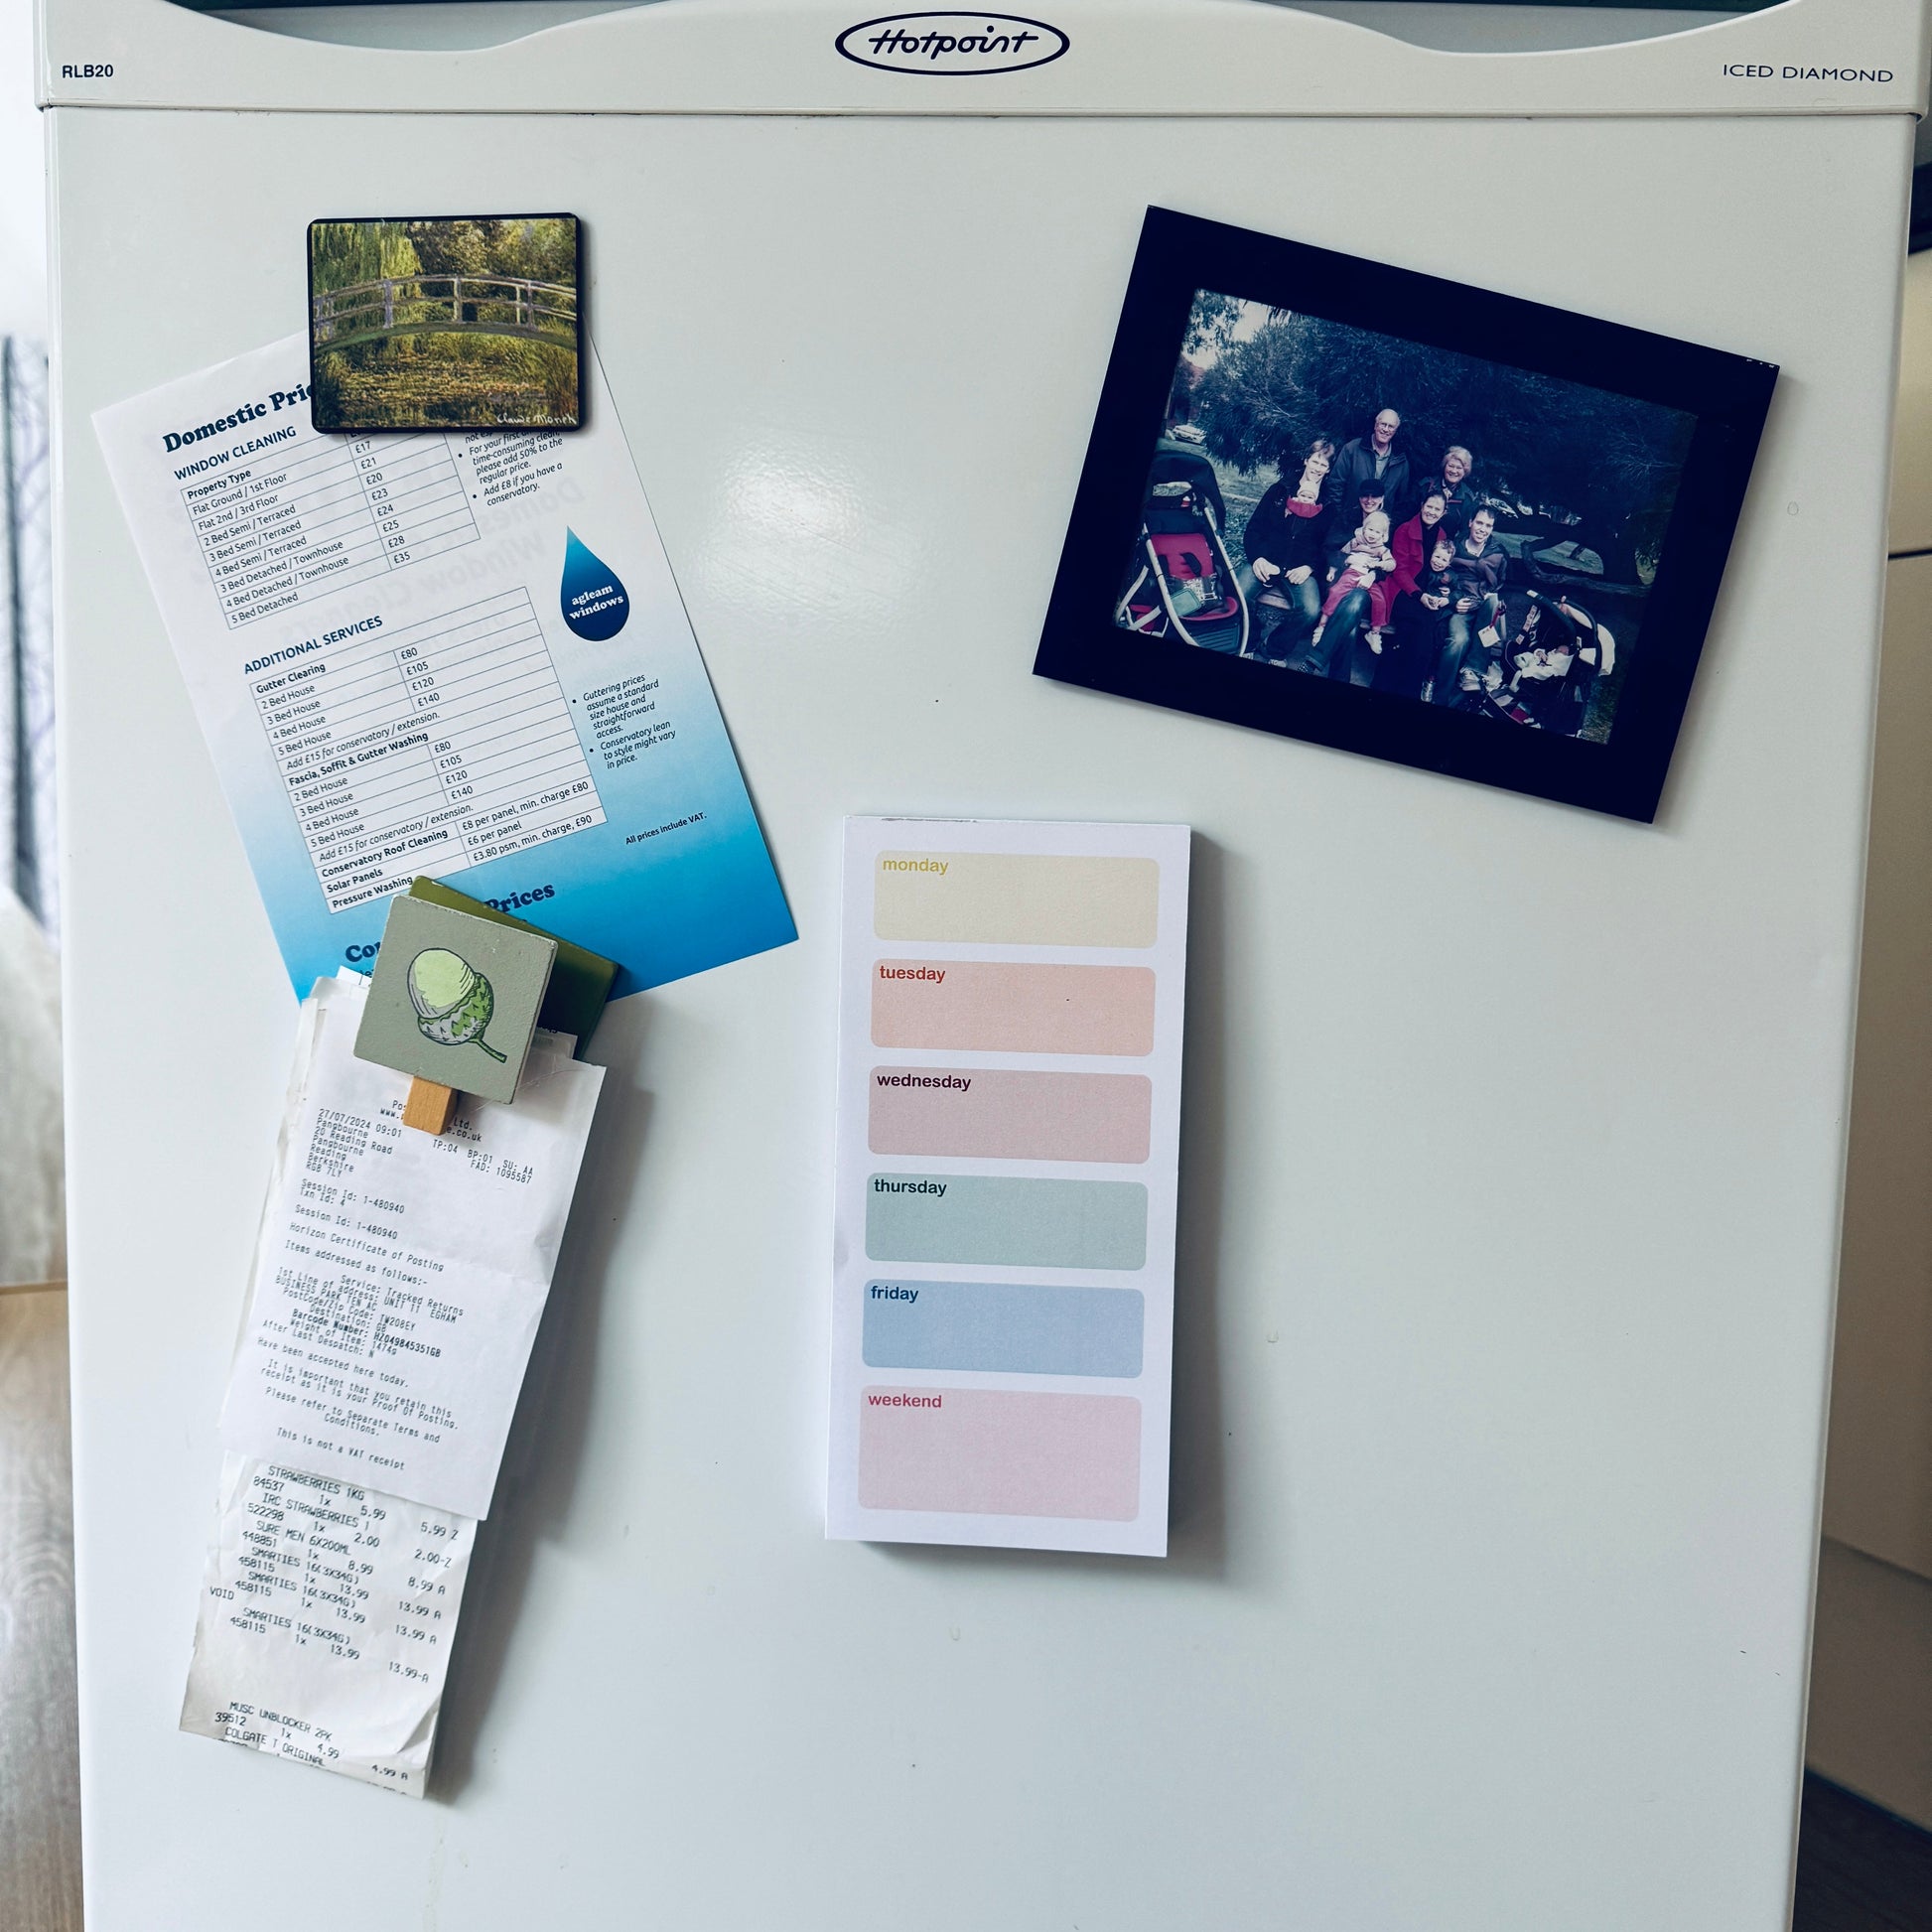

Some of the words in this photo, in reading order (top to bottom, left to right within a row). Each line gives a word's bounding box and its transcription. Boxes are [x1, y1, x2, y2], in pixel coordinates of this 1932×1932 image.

[869, 26, 1038, 60] Hotpoint
[63, 65, 113, 78] RLB20
[1724, 65, 1773, 77] ICED
[1783, 67, 1892, 81] DIAMOND
[162, 403, 267, 453] Domestic
[174, 450, 229, 480] WINDOW
[231, 425, 296, 458] CLEANING
[354, 440, 370, 453] £17
[476, 460, 501, 477] please
[502, 452, 519, 465] add
[519, 444, 537, 460] 50%
[538, 443, 548, 452] to
[548, 438, 562, 448] the
[360, 457, 376, 469] £21
[479, 468, 507, 484] regular
[508, 461, 531, 476] price.
[187, 479, 226, 499] Property
[226, 470, 251, 483] Type
[365, 472, 383, 484] £20
[483, 483, 499, 496] Add
[500, 479, 511, 489] £8
[512, 475, 518, 487] if
[519, 472, 535, 485] you
[535, 465, 555, 478] have
[371, 487, 388, 500] £23
[486, 483, 541, 506] conservatory.
[376, 503, 393, 516] £24
[382, 519, 399, 532] £25
[387, 535, 405, 548] £28
[393, 550, 410, 564] £35
[571, 585, 614, 605] agleam
[231, 614, 238, 623] 5
[237, 607, 256, 621] Bed
[255, 591, 298, 614] Detached
[569, 596, 623, 619] windows
[244, 638, 322, 674] ADDITIONAL
[322, 615, 382, 645] SERVICES
[400, 646, 418, 659] £80
[256, 677, 286, 693] Gutter
[287, 663, 326, 682] Clearing
[406, 660, 429, 675] £105
[411, 676, 434, 691] £120
[583, 682, 621, 701] Guttering
[621, 674, 645, 689] prices
[586, 695, 616, 711] assume
[623, 678, 659, 698] standard
[261, 700, 268, 709] 2
[268, 693, 287, 706] Bed
[286, 685, 315, 700] House
[417, 692, 440, 706] £140
[589, 709, 605, 720] size
[606, 701, 629, 715] house
[630, 693, 646, 706] and
[593, 701, 655, 730] straightforward
[596, 724, 623, 739] access.
[600, 727, 651, 750] Conservatory
[652, 721, 670, 732] lean
[614, 744, 632, 757] style
[633, 735, 658, 750] might
[657, 730, 675, 741] vary
[288, 770, 320, 785] Fascia,
[320, 759, 347, 774] Soffit
[356, 746, 387, 761] Gutter
[387, 733, 429, 751] Washing
[616, 754, 637, 767] price.
[462, 819, 474, 830] £8
[475, 815, 489, 828] per
[490, 804, 519, 822] panel,
[519, 799, 539, 811] min.
[540, 788, 570, 803] charge
[571, 780, 589, 793] £80
[468, 835, 480, 845] £6
[480, 830, 494, 843] per
[496, 819, 522, 838] panel
[473, 846, 497, 861] £3.80
[498, 841, 520, 854] psm,
[520, 834, 541, 845] min.
[541, 823, 575, 838] charge,
[575, 814, 592, 827] £90
[625, 834, 636, 845] All
[636, 828, 660, 842] prices
[659, 818, 688, 833] include
[687, 811, 707, 822] VAT.
[321, 852, 382, 877] Conservatory
[383, 841, 406, 856] Roof
[407, 830, 448, 848] Cleaning
[884, 858, 948, 875] monday
[326, 880, 350, 893] Solar
[351, 868, 383, 884] Panels
[332, 890, 372, 907] Pressure
[372, 876, 413, 894] Washing
[880, 966, 945, 983] tuesday
[877, 1073, 971, 1091] wednesday
[875, 1178, 946, 1197] thursday
[871, 1286, 918, 1303] friday
[869, 1394, 941, 1408] weekend
[267, 1464, 341, 1494] STRAWBERRIES
[346, 1487, 364, 1501] 1KG
[253, 1475, 284, 1492] 84537
[319, 1493, 331, 1506] 1x
[359, 1504, 386, 1520] 5.99
[420, 1521, 446, 1537] 5.99
[210, 1587, 234, 1599] VOID
[259, 1709, 311, 1732] UNBLOCKER
[281, 1726, 291, 1739] 1x
[317, 1743, 339, 1759] 4.99
[371, 1764, 396, 1777] 4.99
